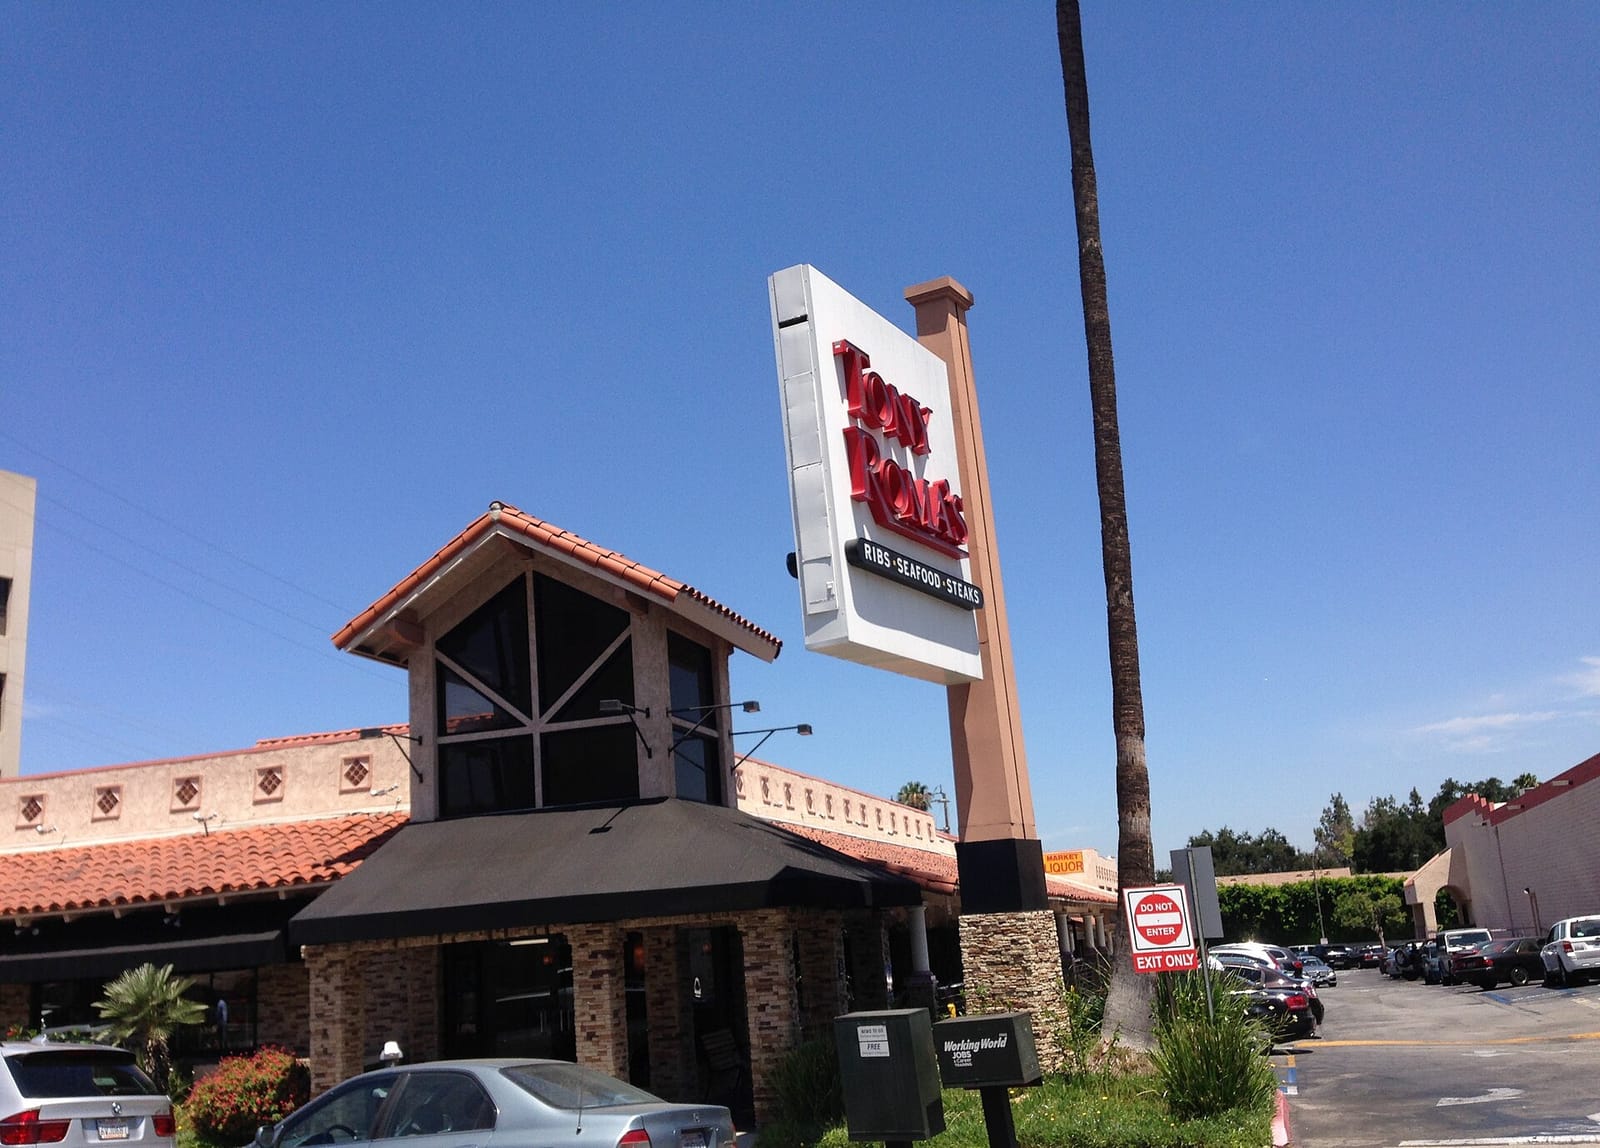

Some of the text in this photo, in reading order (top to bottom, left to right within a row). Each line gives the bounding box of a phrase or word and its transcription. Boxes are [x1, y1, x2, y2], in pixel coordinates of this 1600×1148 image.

[832, 339, 933, 455] TONY
[864, 543, 980, 604] RIBS SEAFOOD STEAKS
[1046, 853, 1079, 861] MARKET
[1140, 902, 1173, 912] DO NOT
[1146, 927, 1176, 937] ENTER
[1136, 953, 1194, 970] EXIT ONLY
[944, 1036, 1008, 1053] Working World
[952, 1050, 972, 1060] JOBS
